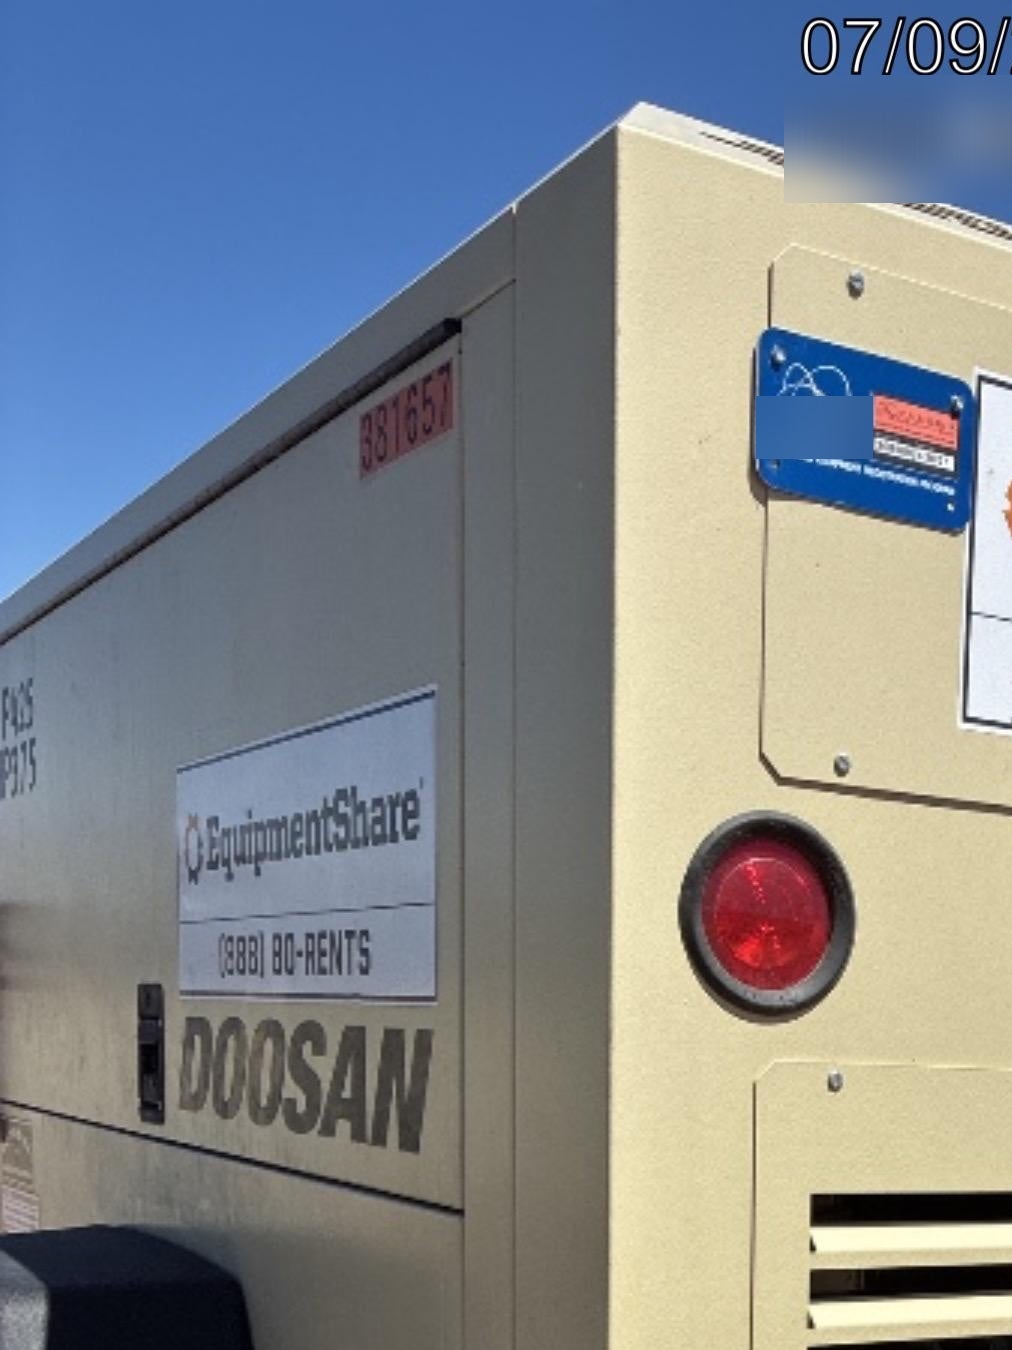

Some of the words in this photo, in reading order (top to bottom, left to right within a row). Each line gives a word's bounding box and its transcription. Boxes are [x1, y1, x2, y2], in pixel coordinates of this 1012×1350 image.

[361, 361, 451, 472] 381657
[205, 785, 421, 882] EquipmentShare
[217, 930, 265, 979] (888)
[271, 928, 371, 977] 80-RENTS
[179, 1016, 435, 1153] DOOSAN
